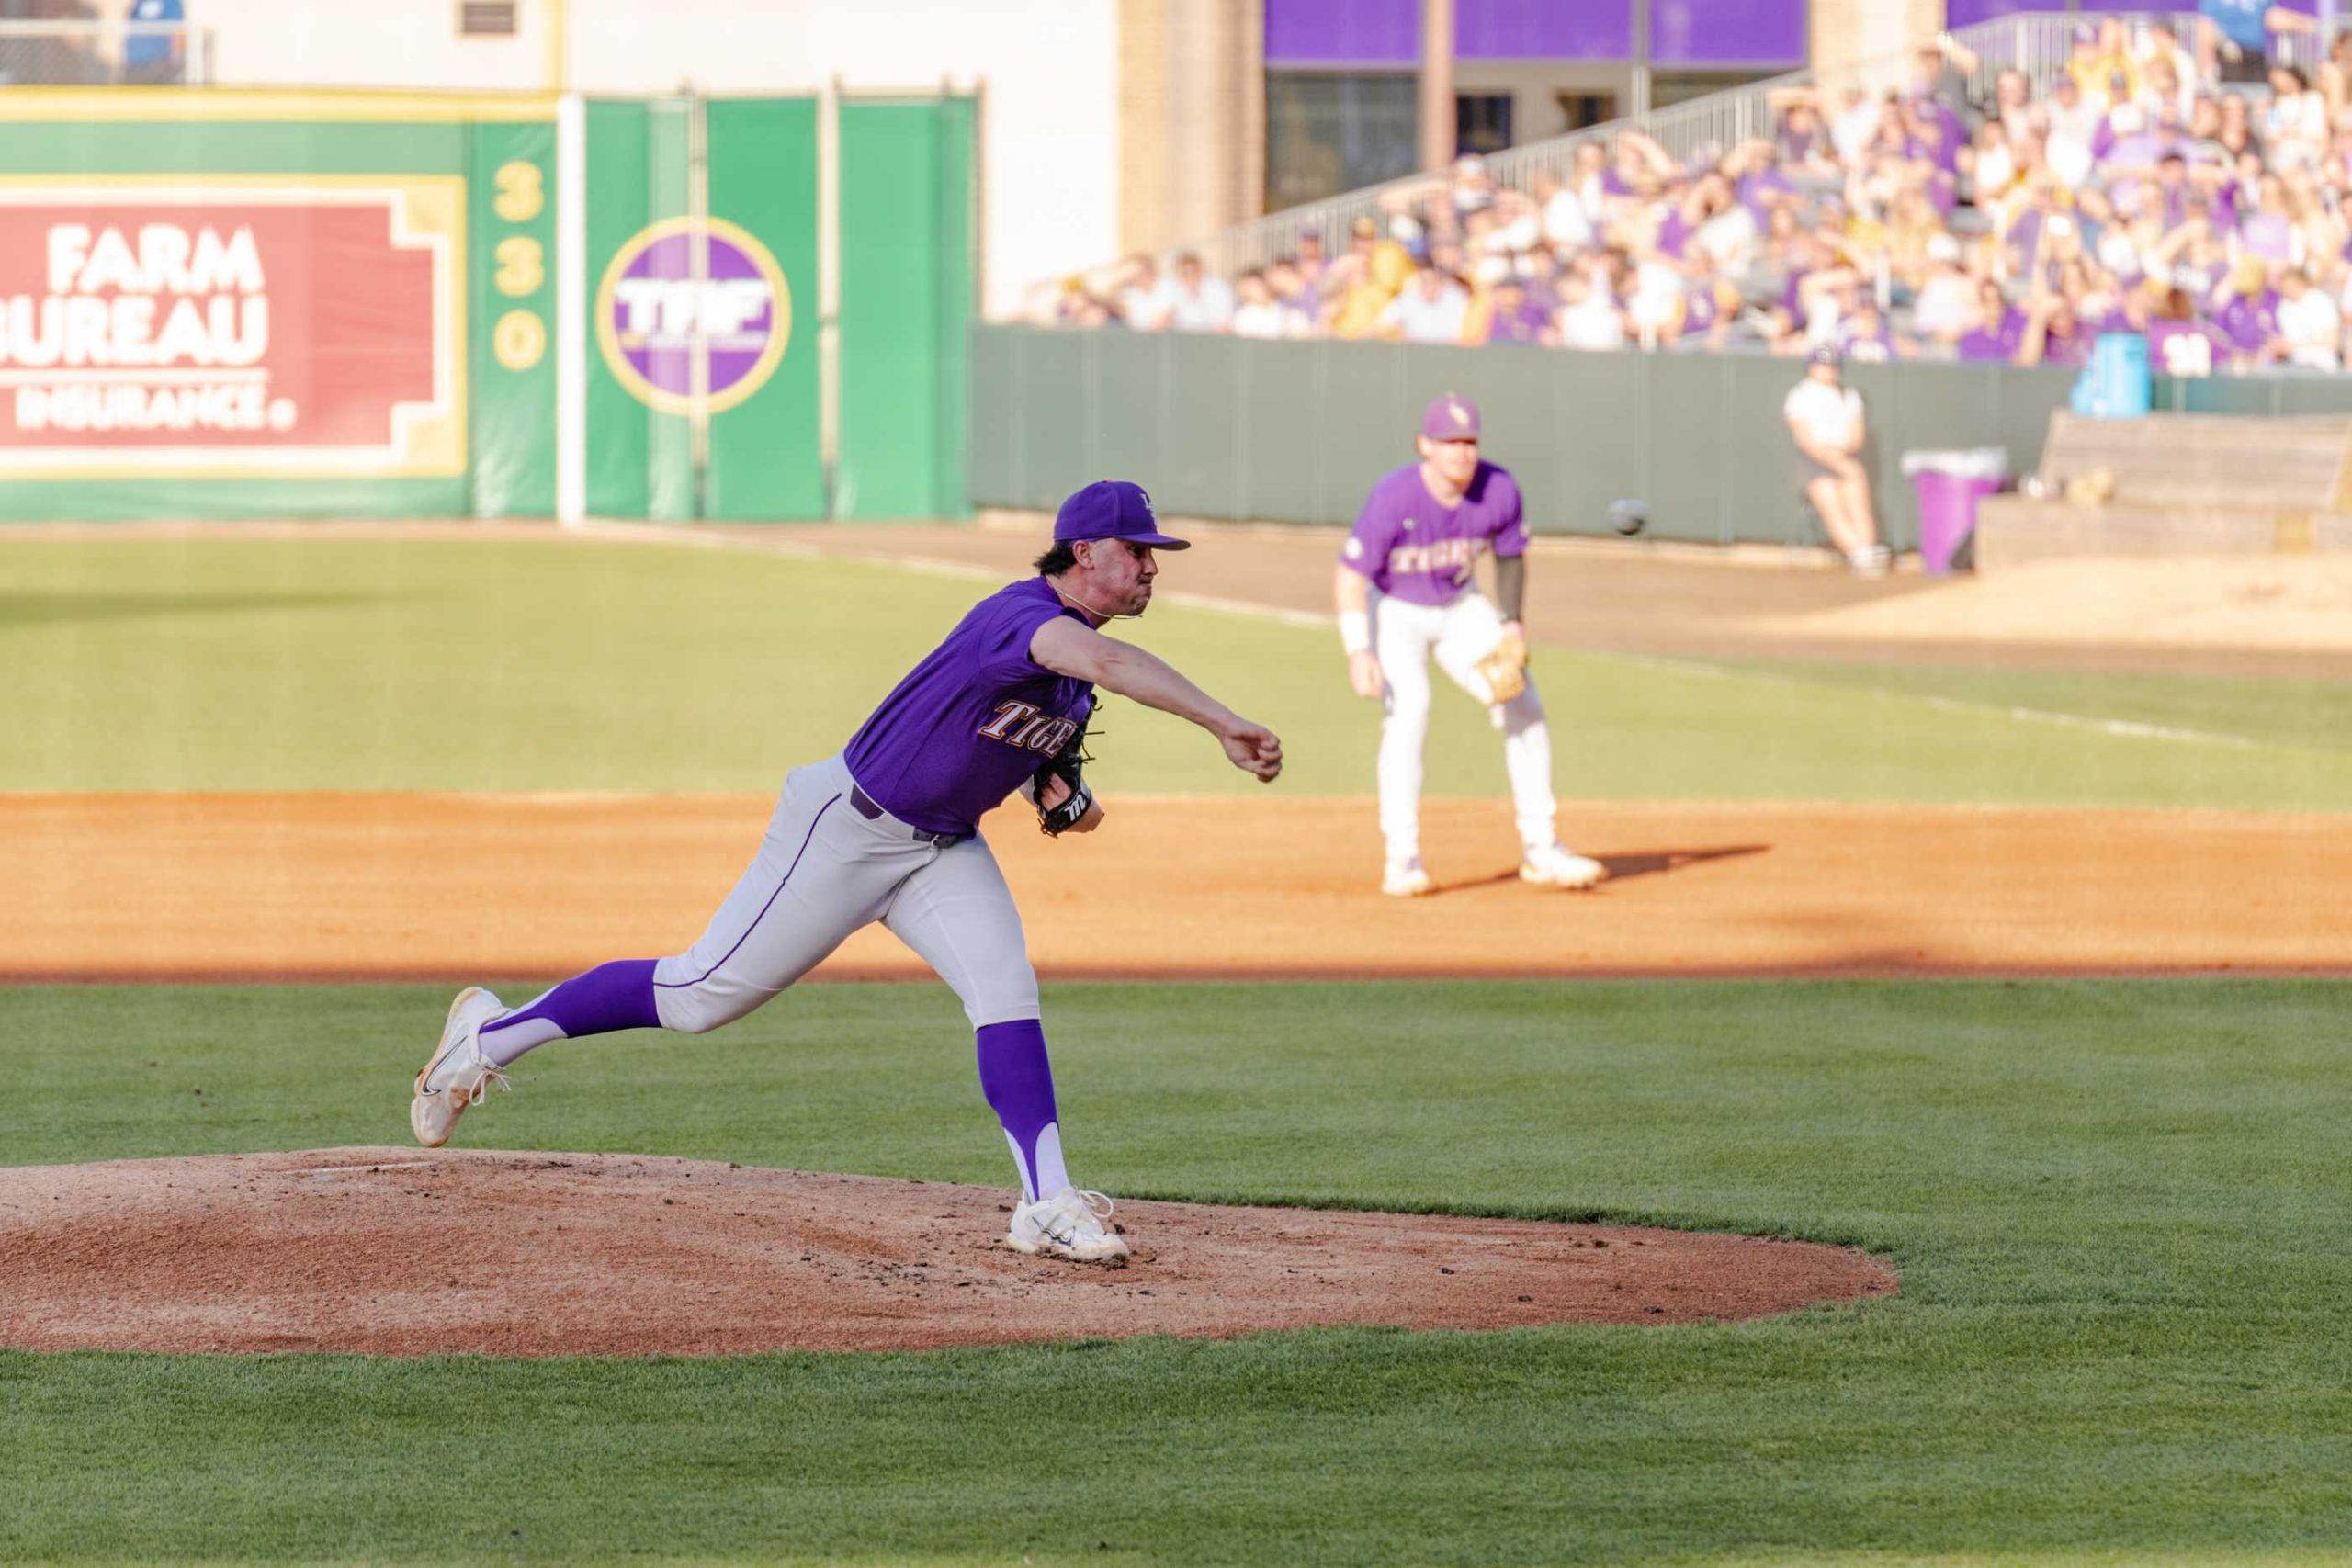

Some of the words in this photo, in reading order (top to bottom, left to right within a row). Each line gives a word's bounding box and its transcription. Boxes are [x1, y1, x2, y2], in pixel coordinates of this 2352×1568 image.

[49, 223, 266, 293] FARM
[493, 160, 546, 372] 330
[0, 293, 269, 367] UREAU
[978, 699, 1078, 759] TIGE
